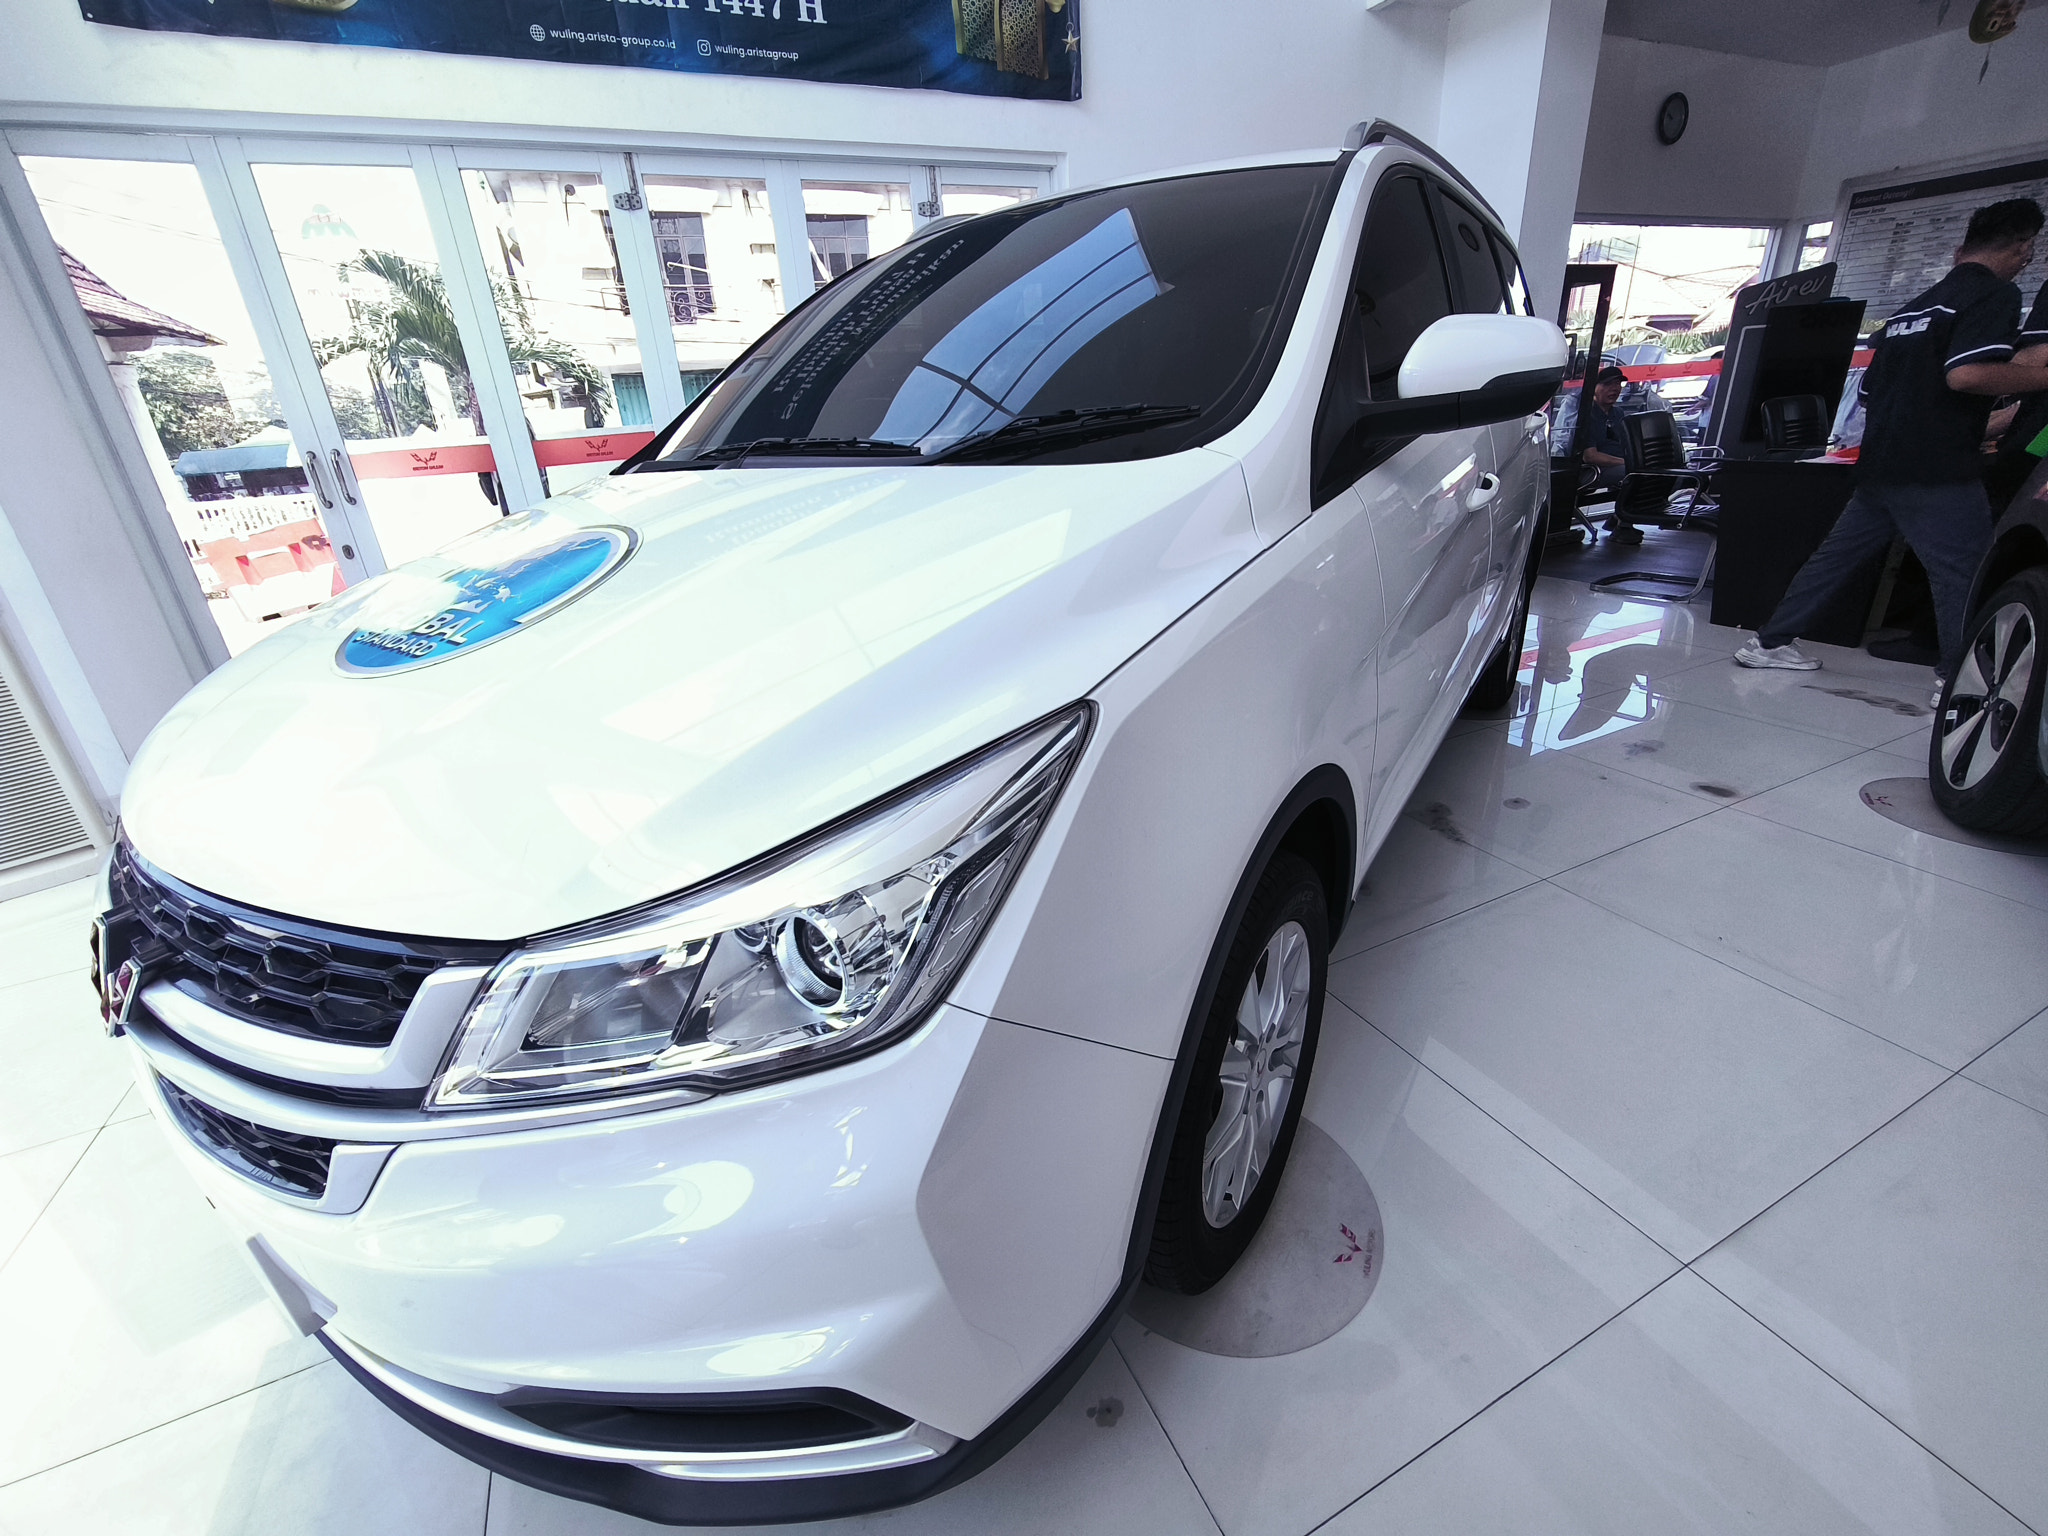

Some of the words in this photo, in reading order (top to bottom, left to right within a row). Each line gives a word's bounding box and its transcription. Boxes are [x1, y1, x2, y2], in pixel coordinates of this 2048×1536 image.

[797, 0, 828, 24] H
[549, 28, 677, 49] wuling.arista-group.co.id
[714, 44, 799, 61] wuling.aristagroup
[355, 630, 438, 657] STANDARD
